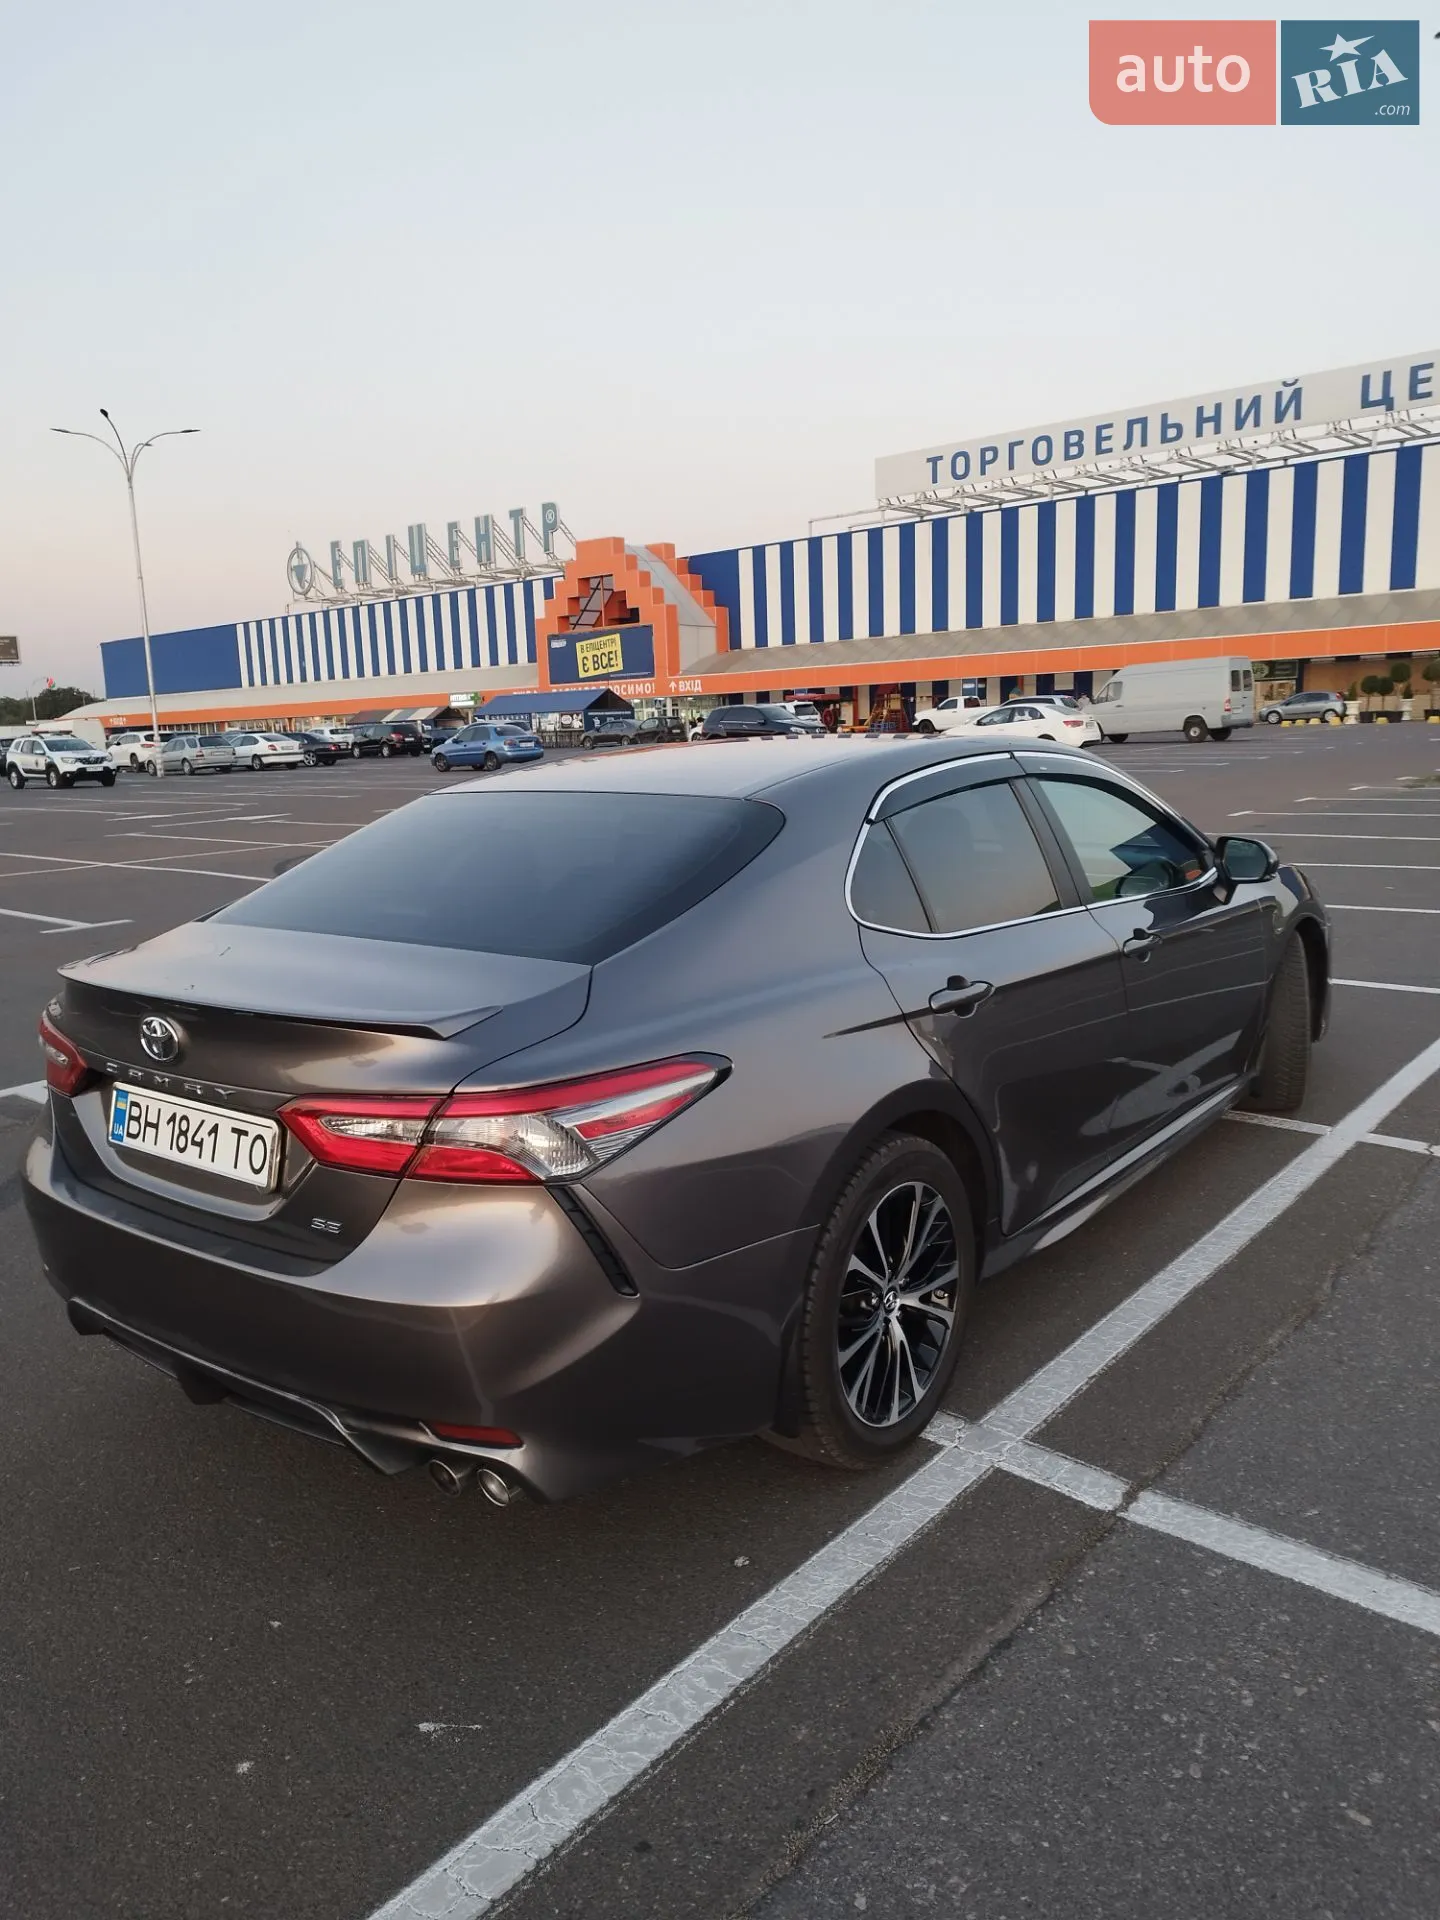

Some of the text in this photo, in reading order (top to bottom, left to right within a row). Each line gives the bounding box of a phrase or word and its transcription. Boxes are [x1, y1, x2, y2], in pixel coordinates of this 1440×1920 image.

[926, 362, 1435, 485] ТОРГОВЕЛЬНИЙ ЦЕ
[330, 502, 560, 589] ЕПІЦЕНТР
[592, 650, 619, 671] ВСЕ!
[678, 679, 702, 692] ВХІД
[106, 1062, 237, 1100] CAMRY
[113, 1123, 124, 1136] UA
[166, 1112, 219, 1163] 1841
[311, 1217, 342, 1234] SE
